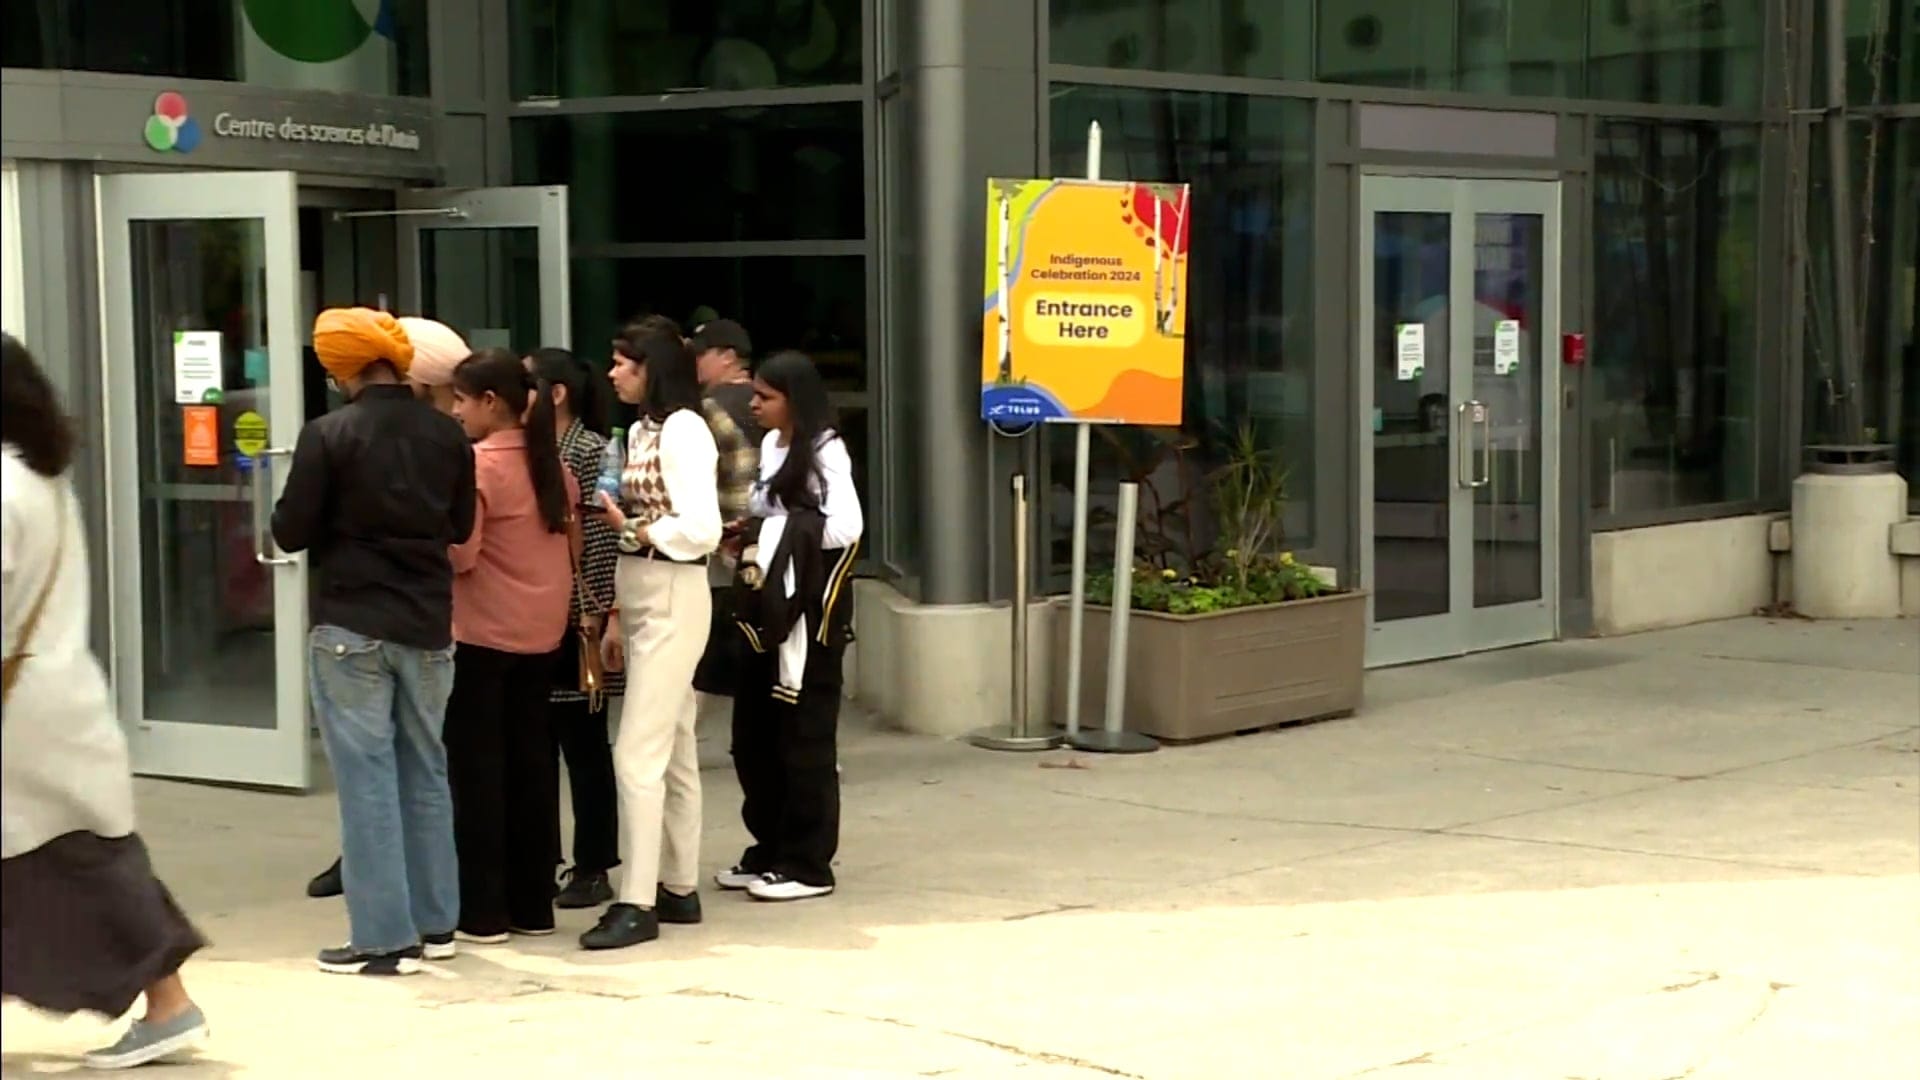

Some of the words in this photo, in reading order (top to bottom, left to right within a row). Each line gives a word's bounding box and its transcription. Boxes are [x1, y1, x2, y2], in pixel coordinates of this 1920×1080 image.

[214, 112, 275, 138] Centre
[280, 116, 307, 139] des
[1050, 254, 1122, 267] Indigenous
[1031, 269, 1107, 280] Celebration
[1110, 271, 1140, 281] 2024
[1036, 299, 1132, 317] Entrance
[1059, 322, 1109, 338] Here
